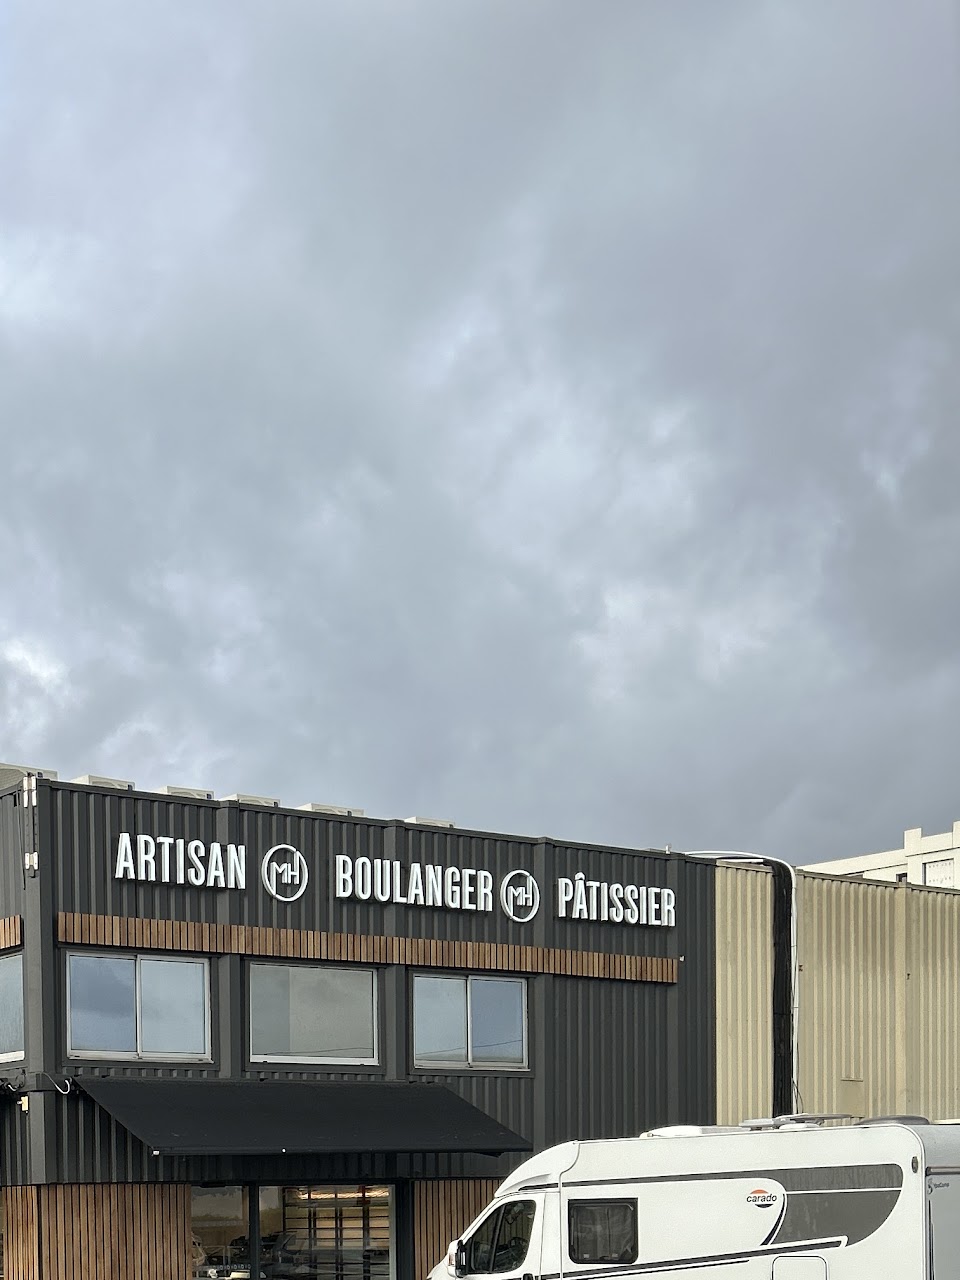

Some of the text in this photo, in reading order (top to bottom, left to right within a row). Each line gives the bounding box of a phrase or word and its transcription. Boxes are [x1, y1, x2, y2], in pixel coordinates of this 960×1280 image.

[114, 832, 246, 890] ARTISAN
[335, 854, 493, 912] BOULANGER
[557, 871, 675, 927] PÂTISSIER
[746, 1193, 778, 1203] carado
